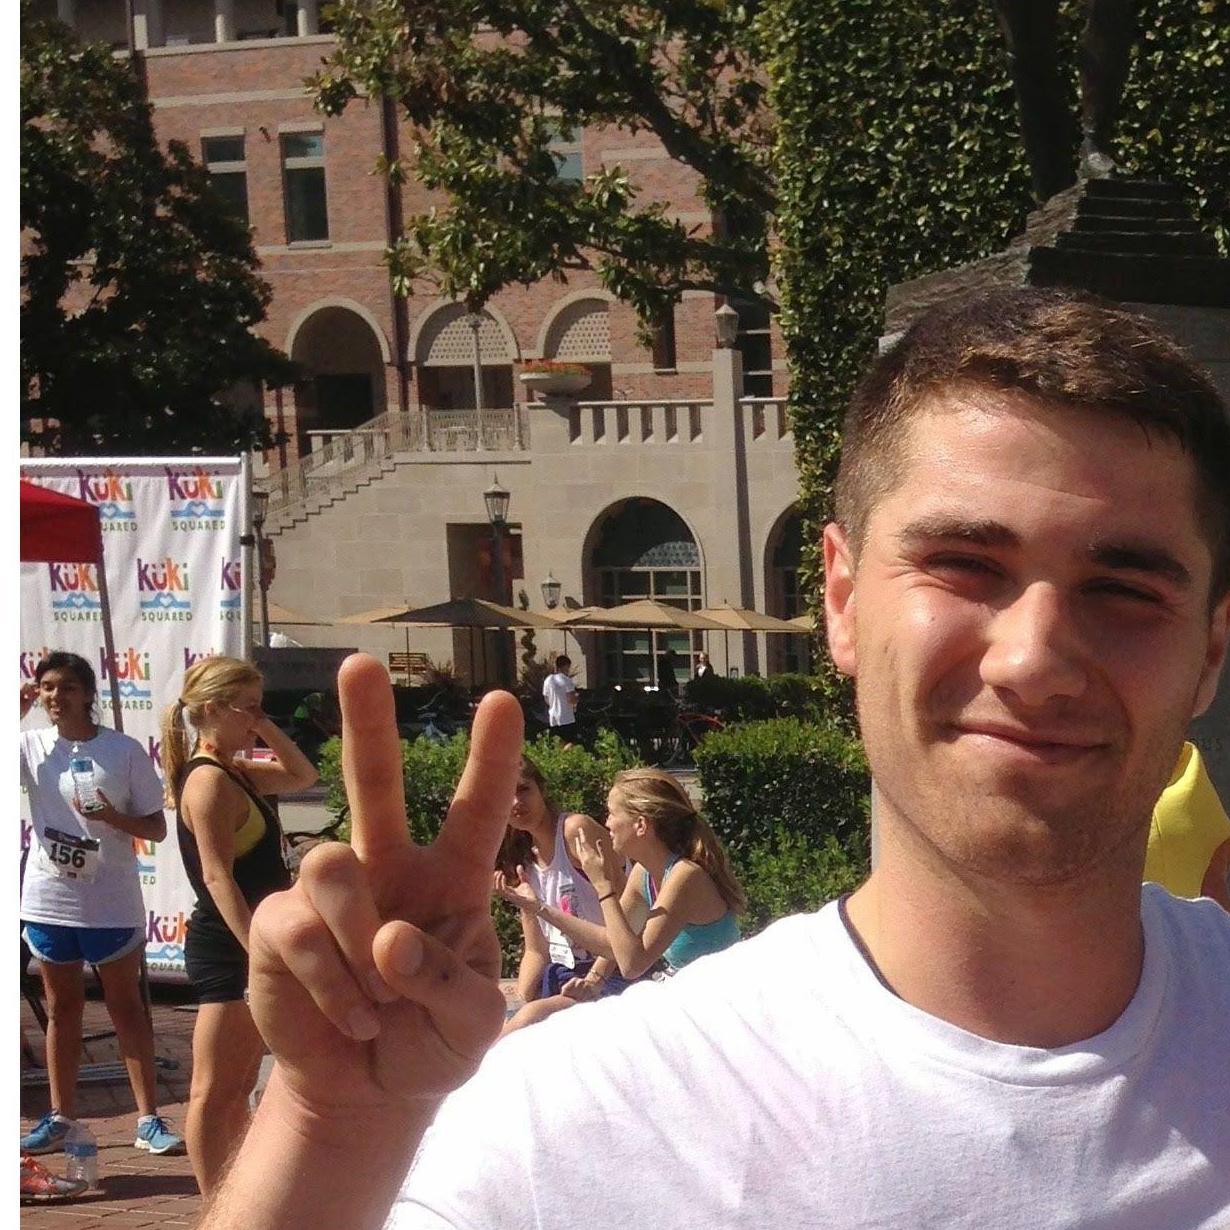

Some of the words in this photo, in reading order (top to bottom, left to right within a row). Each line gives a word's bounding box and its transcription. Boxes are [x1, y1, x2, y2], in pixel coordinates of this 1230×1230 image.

[54, 611, 103, 622] SQUARE
[142, 611, 193, 623] SQUARED
[49, 842, 86, 869] 156
